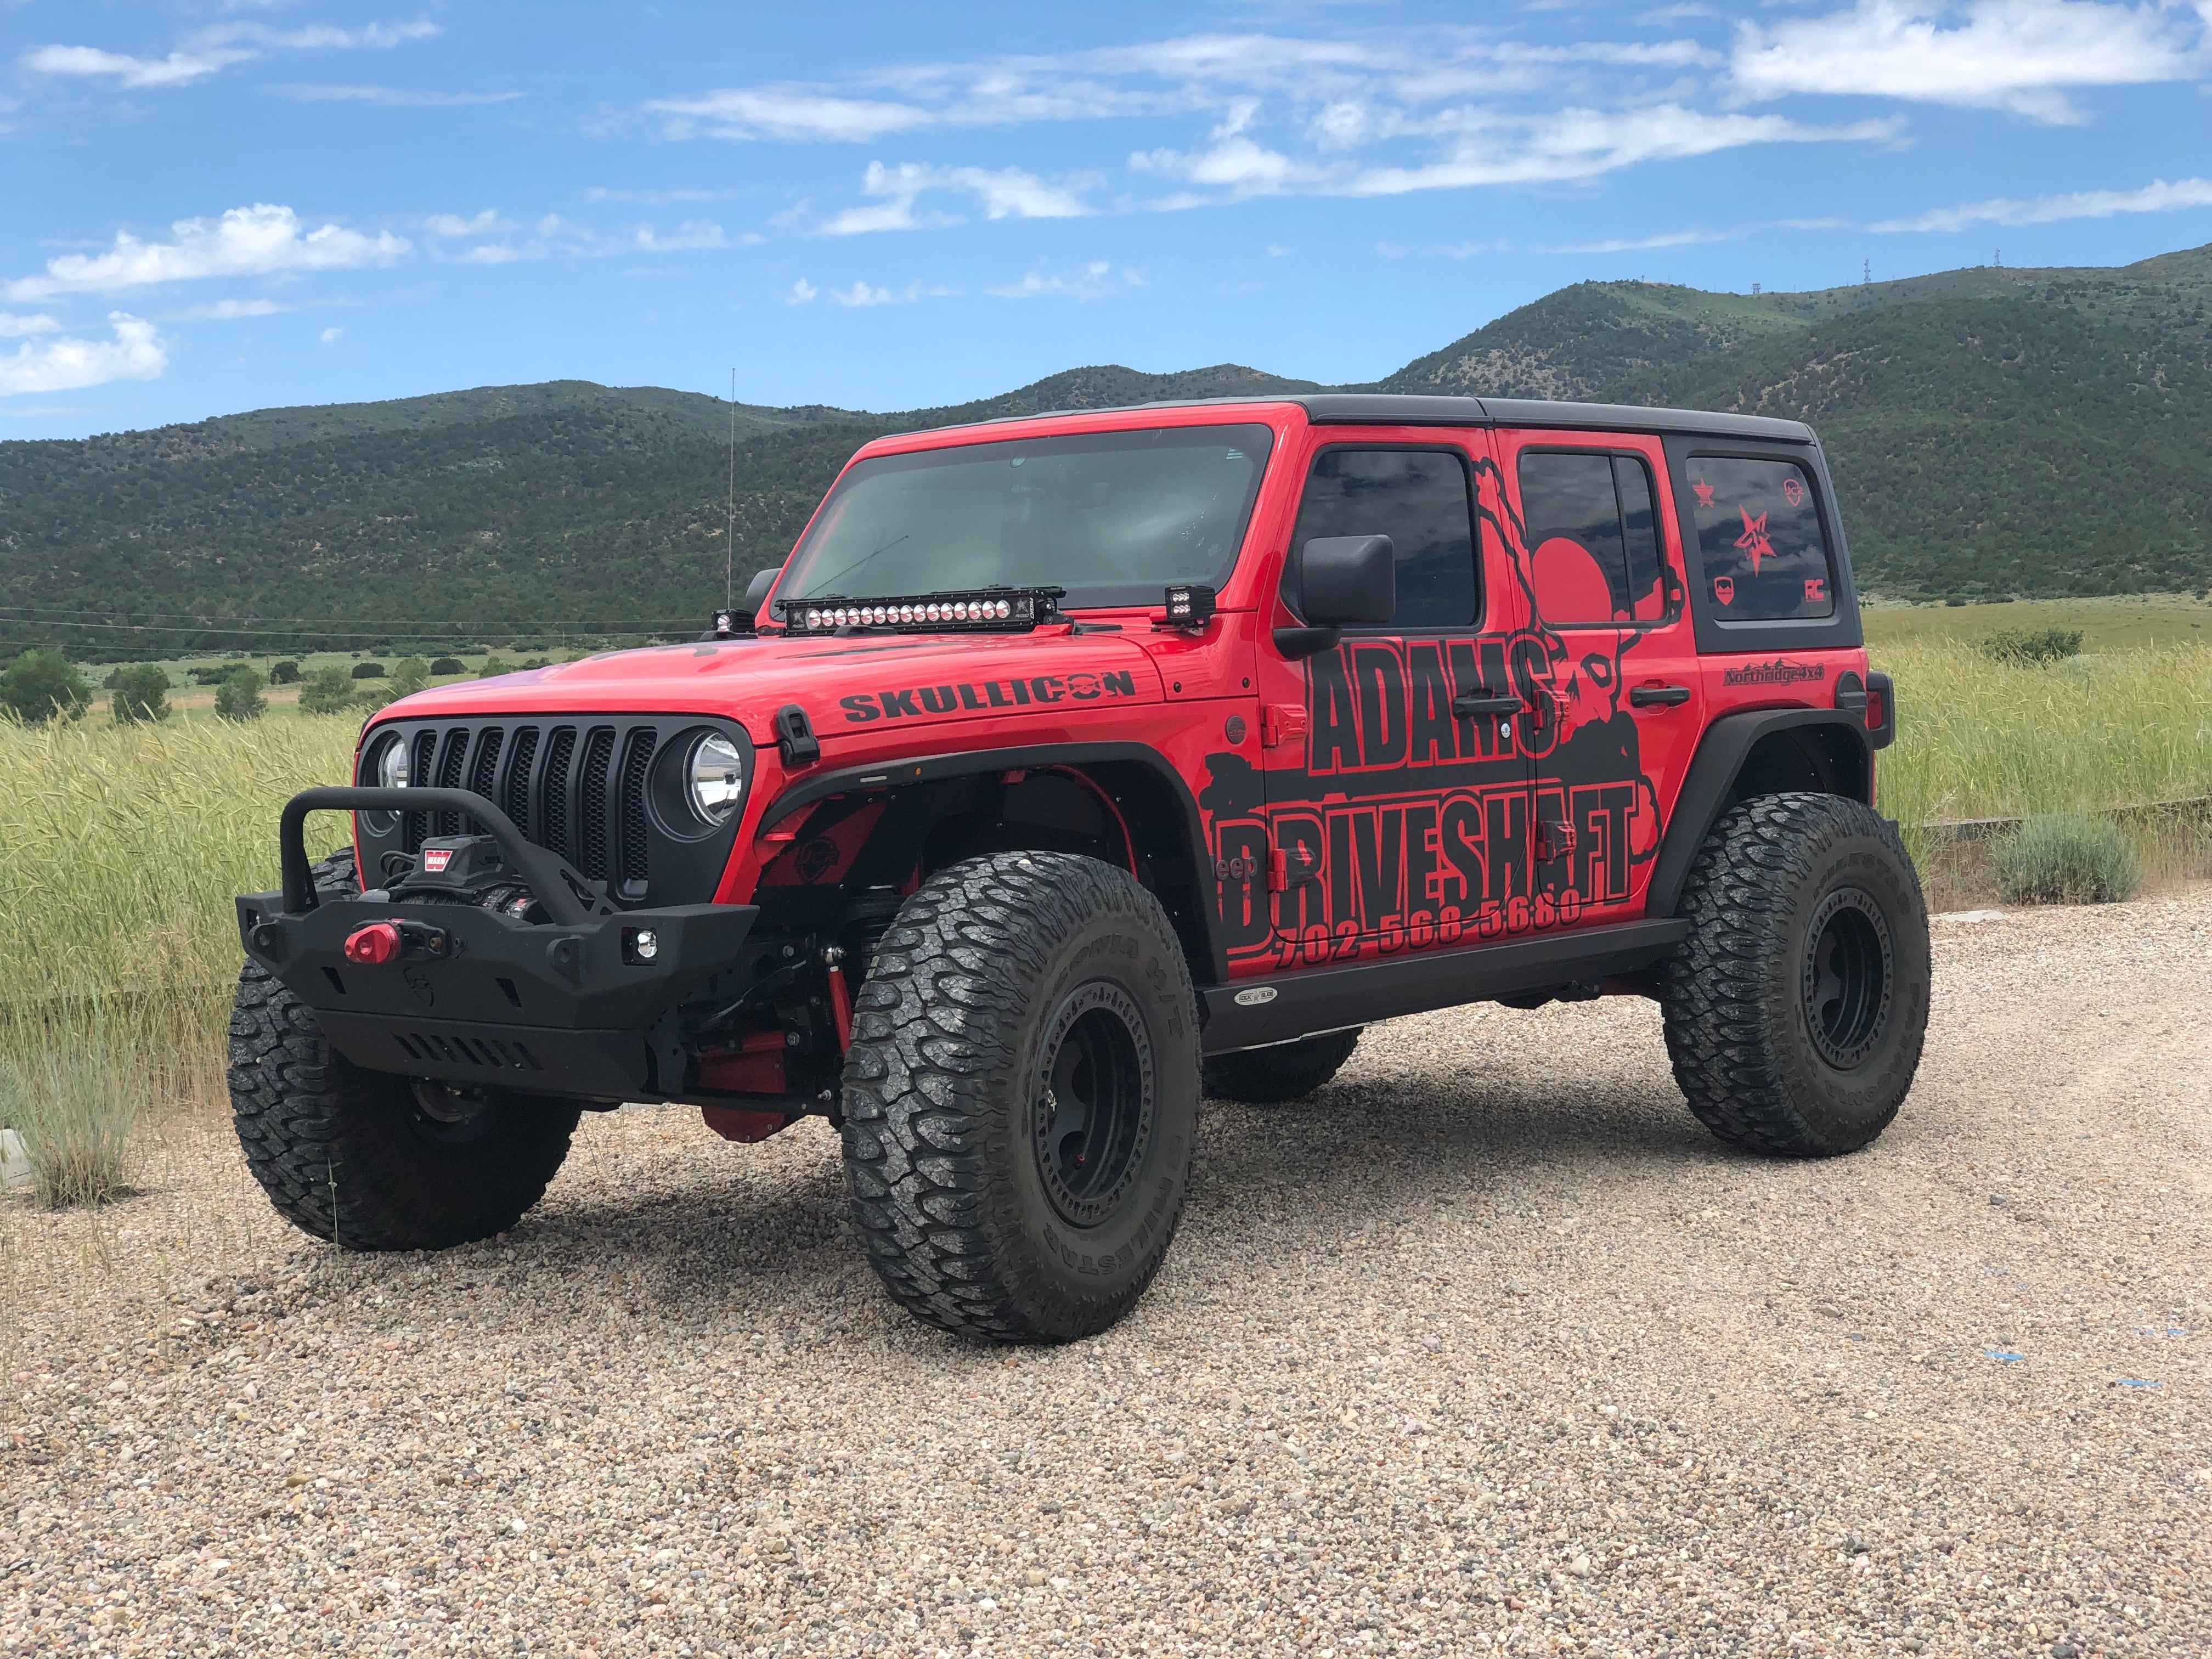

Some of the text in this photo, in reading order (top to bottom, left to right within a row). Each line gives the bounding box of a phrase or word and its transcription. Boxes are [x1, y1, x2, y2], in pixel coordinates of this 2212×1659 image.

[839, 670, 1135, 722] SKULLICON
[1308, 634, 1558, 775] ADAMS
[427, 857, 446, 865] WARN
[1215, 781, 1638, 953] DRIVESHAFT
[1274, 888, 1581, 969] 702-568-5680
